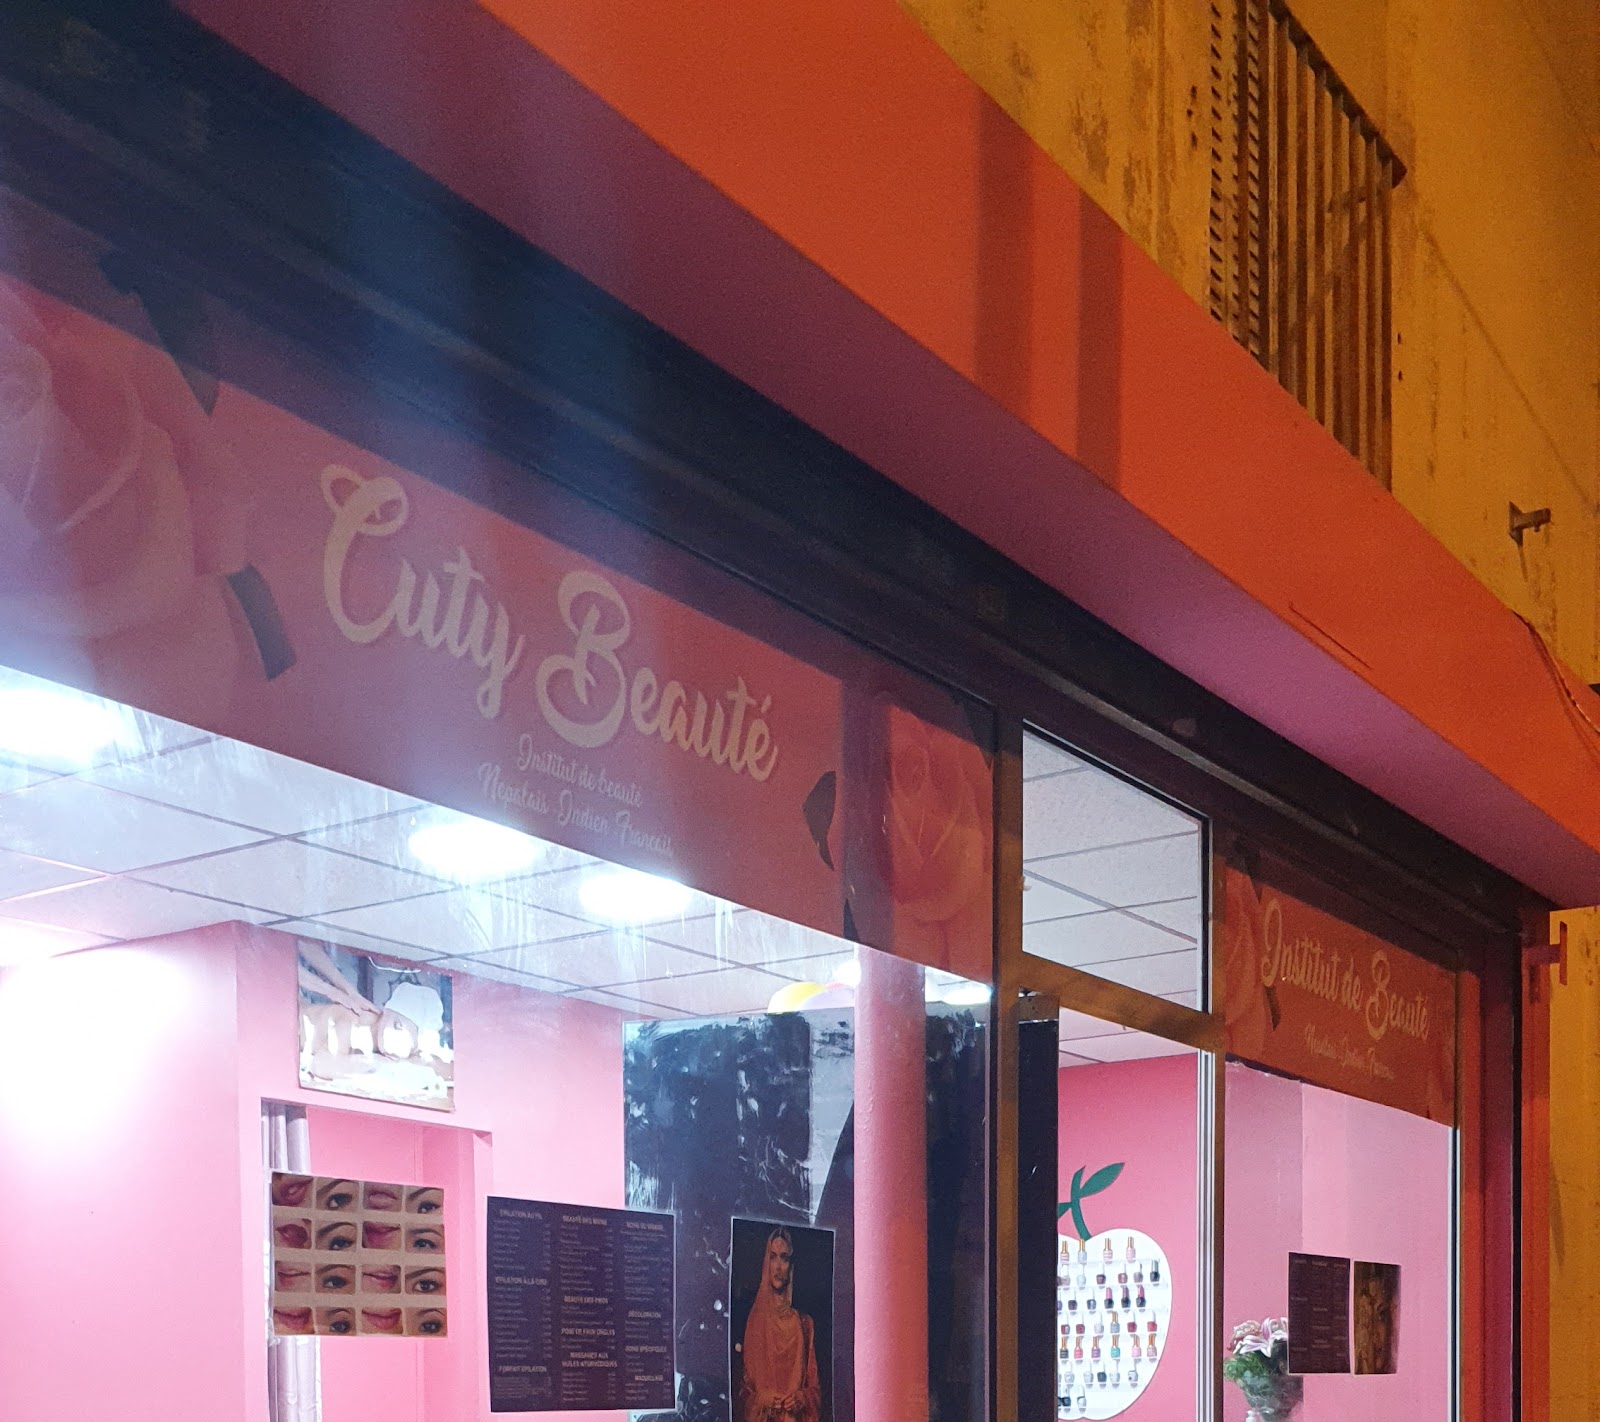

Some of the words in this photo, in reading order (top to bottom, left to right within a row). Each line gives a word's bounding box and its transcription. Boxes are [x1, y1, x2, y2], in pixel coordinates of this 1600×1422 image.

[320, 463, 526, 720] Cuty
[535, 570, 780, 782] Beauté
[517, 733, 578, 784] Institut
[1261, 898, 1339, 1003] Institut
[1342, 956, 1364, 1012] de
